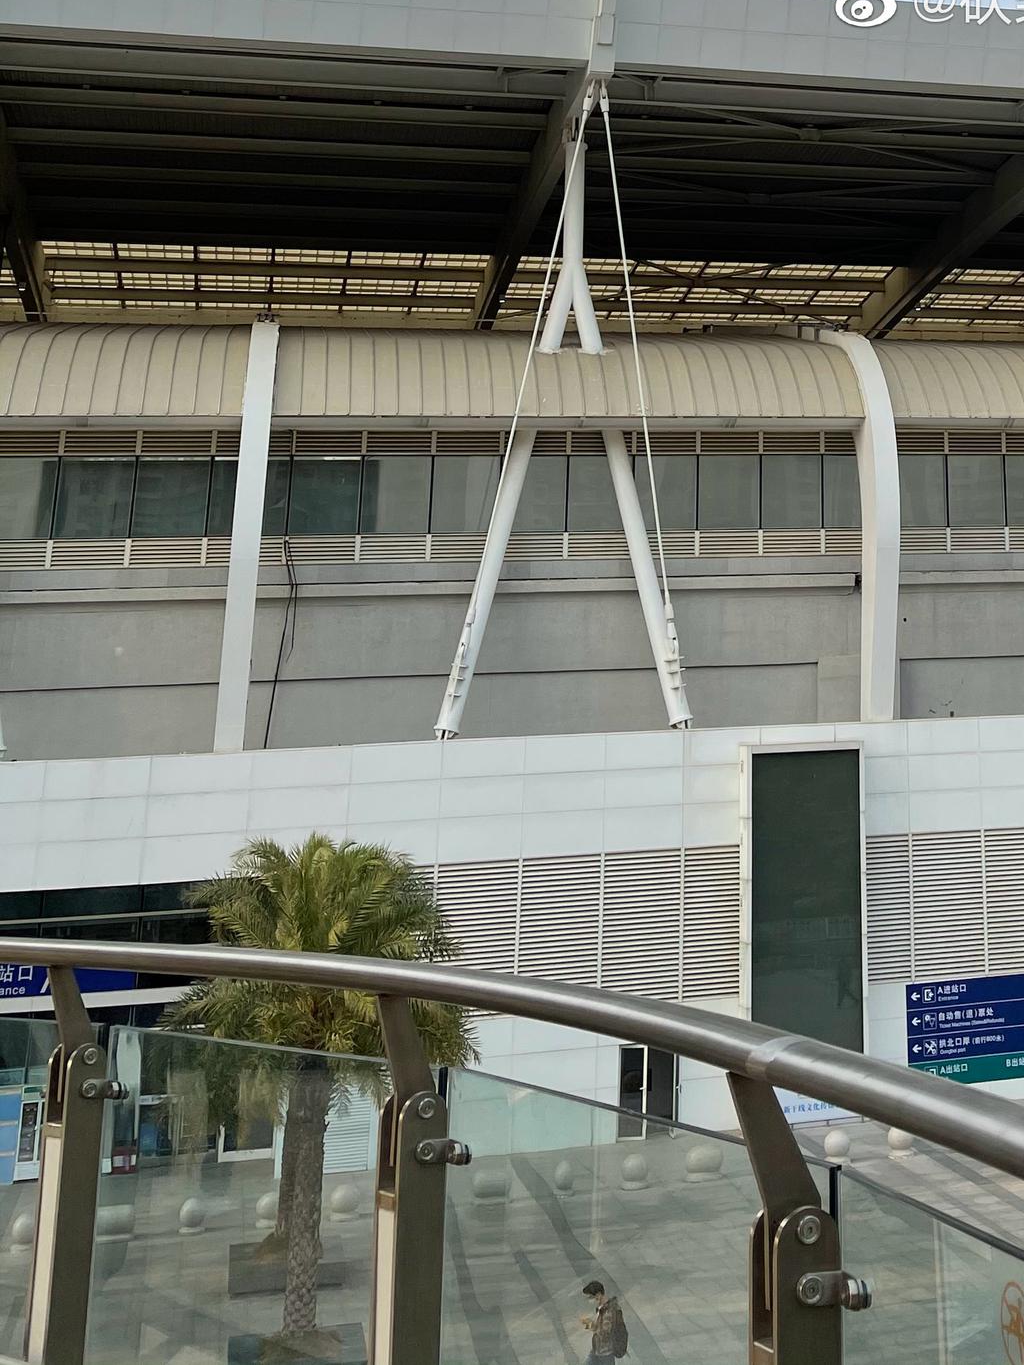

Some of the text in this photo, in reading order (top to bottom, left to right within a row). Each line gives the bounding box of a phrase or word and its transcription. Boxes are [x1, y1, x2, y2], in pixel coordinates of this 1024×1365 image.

[937, 984, 967, 995] A进站口
[939, 1063, 968, 1075] A出站口
